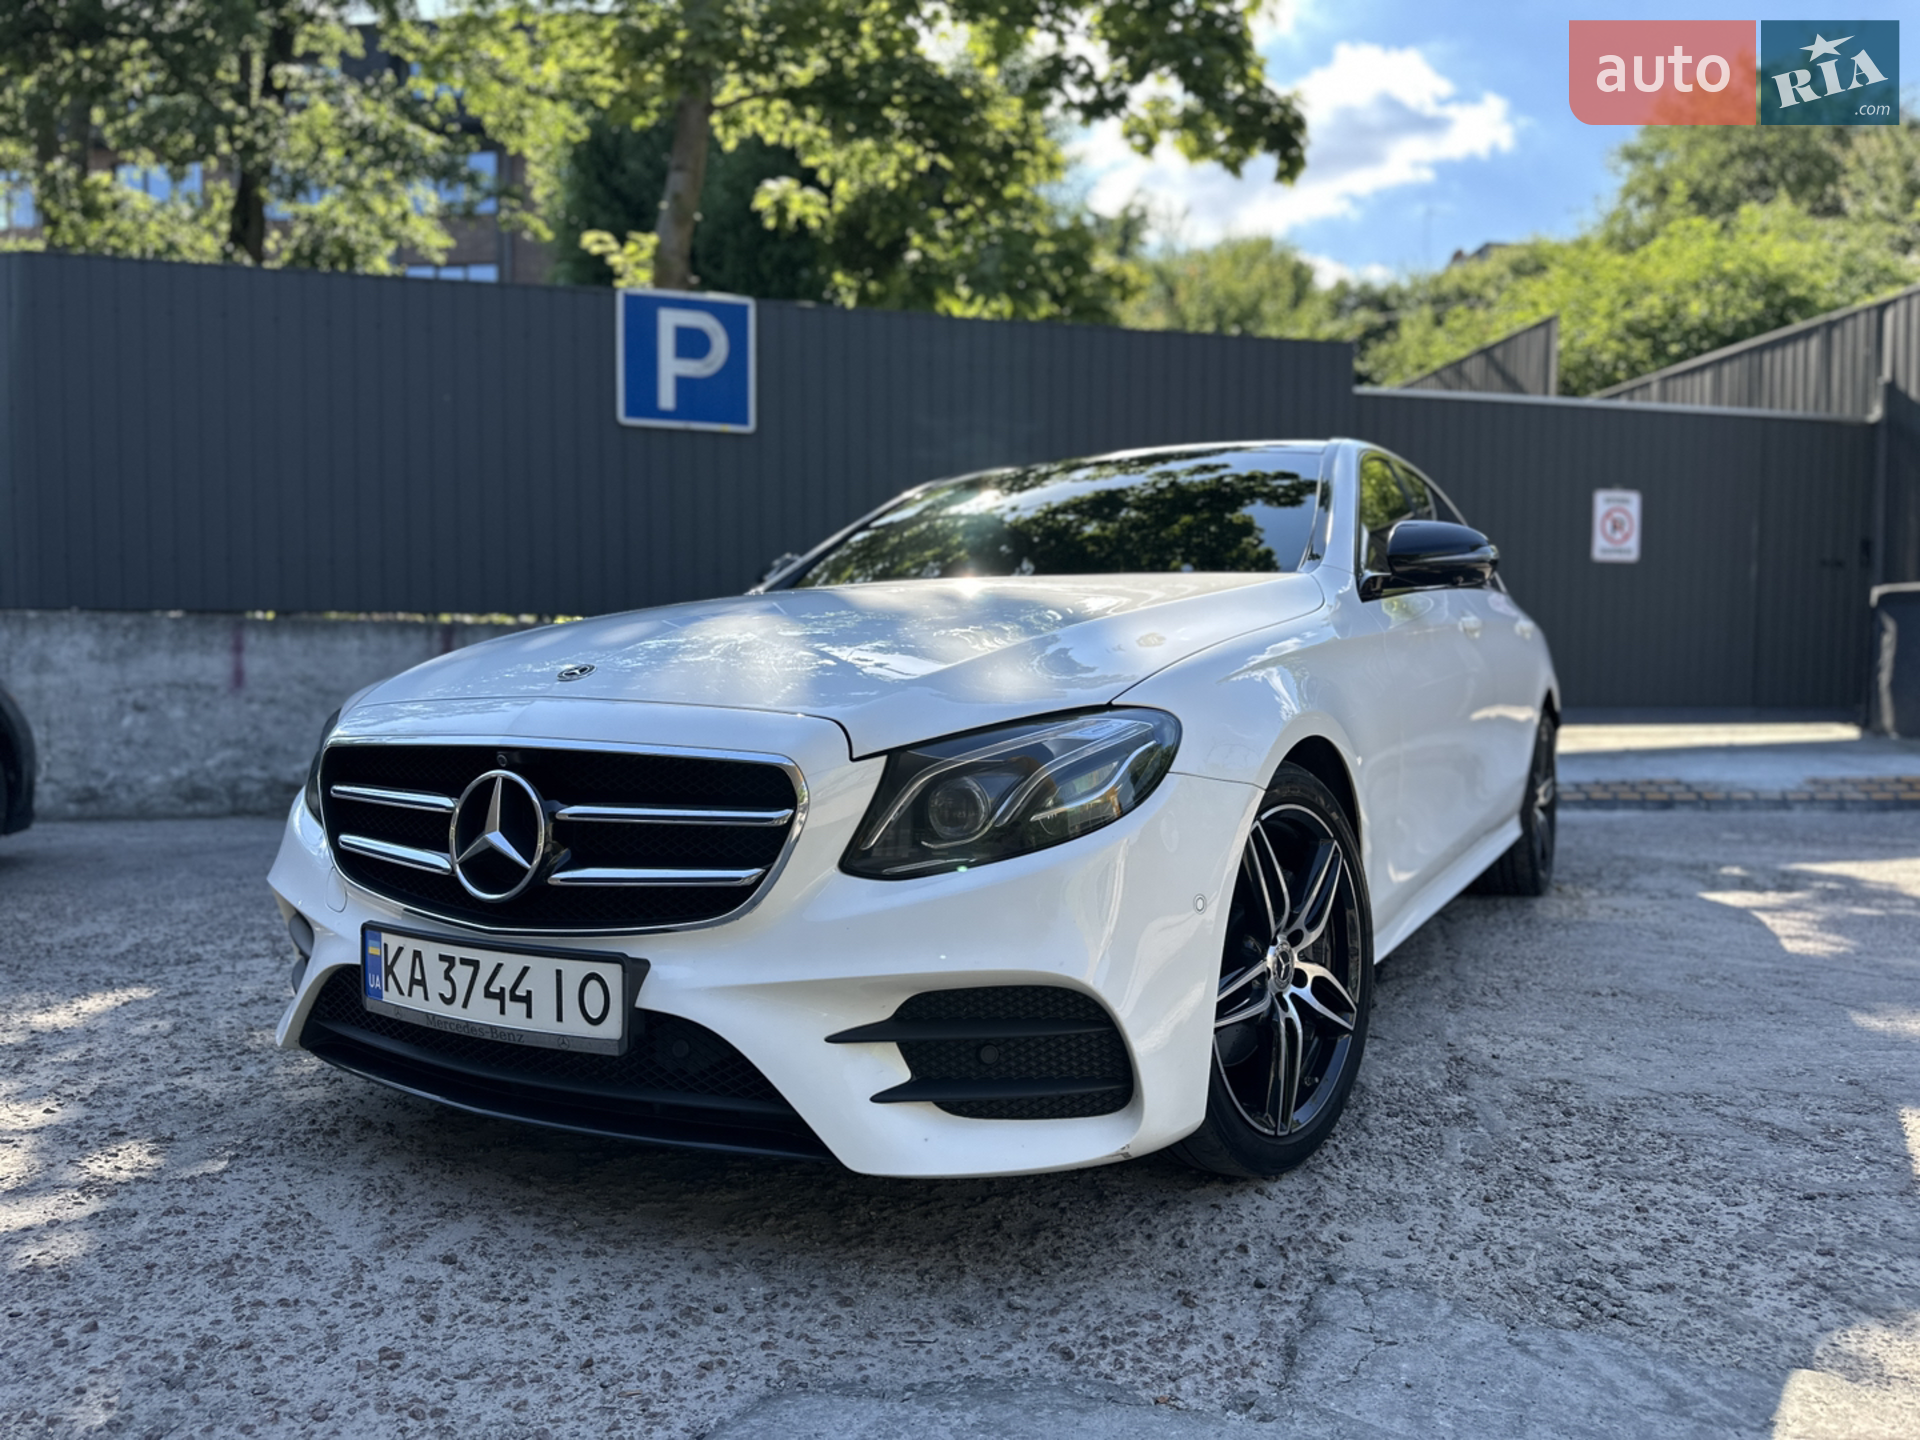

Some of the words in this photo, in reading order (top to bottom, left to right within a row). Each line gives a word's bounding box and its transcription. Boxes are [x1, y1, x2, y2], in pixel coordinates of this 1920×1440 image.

[657, 307, 730, 411] P
[368, 973, 382, 990] UA
[383, 943, 429, 1002] KA
[438, 953, 532, 1018] 3744
[555, 968, 611, 1026] IO
[426, 1014, 525, 1044] Mercedes-Benz
